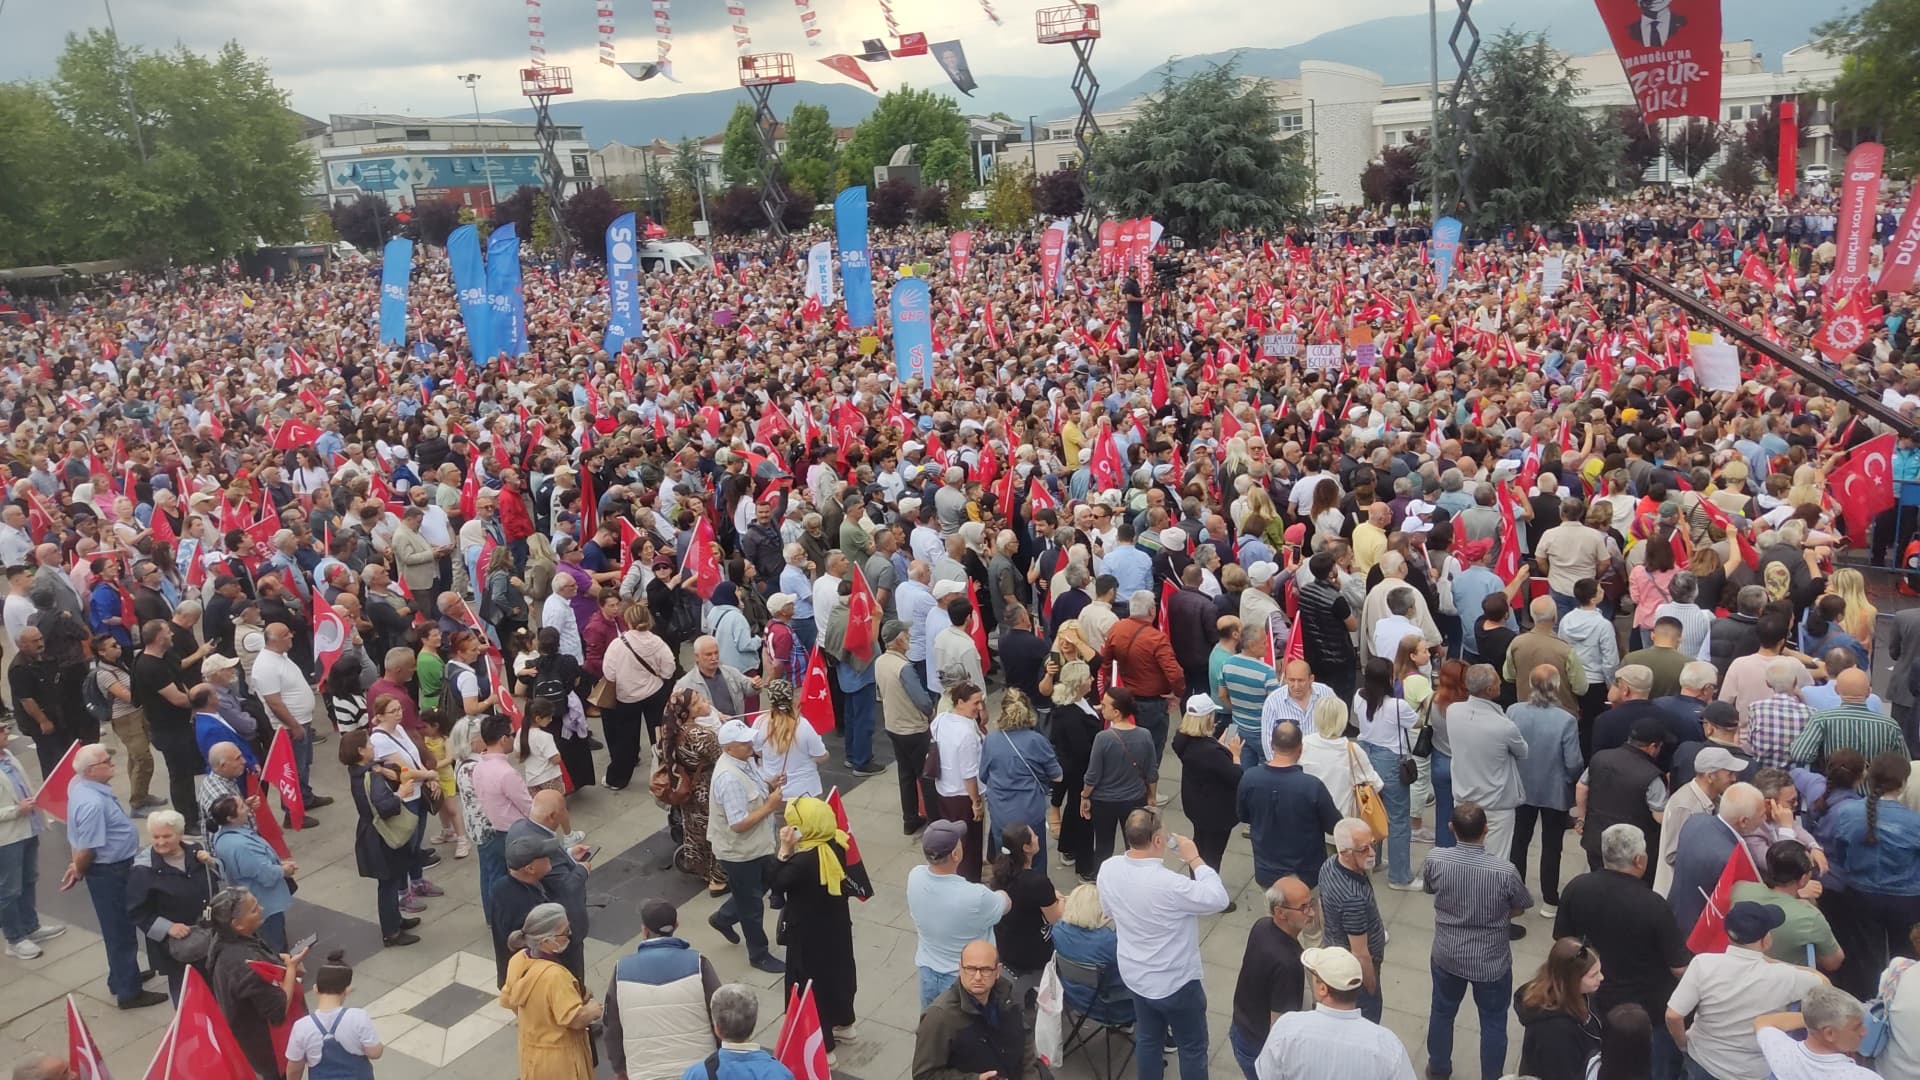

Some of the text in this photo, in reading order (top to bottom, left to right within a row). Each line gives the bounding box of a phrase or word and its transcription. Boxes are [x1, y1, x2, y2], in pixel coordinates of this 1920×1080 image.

[1623, 49, 1691, 69] MAMOĞLU'NA
[1630, 60, 1709, 94] ZGÜR-
[611, 227, 632, 277] SOL
[841, 250, 867, 262] SOL
[461, 287, 486, 300] SOL
[488, 294, 511, 307] SOL
